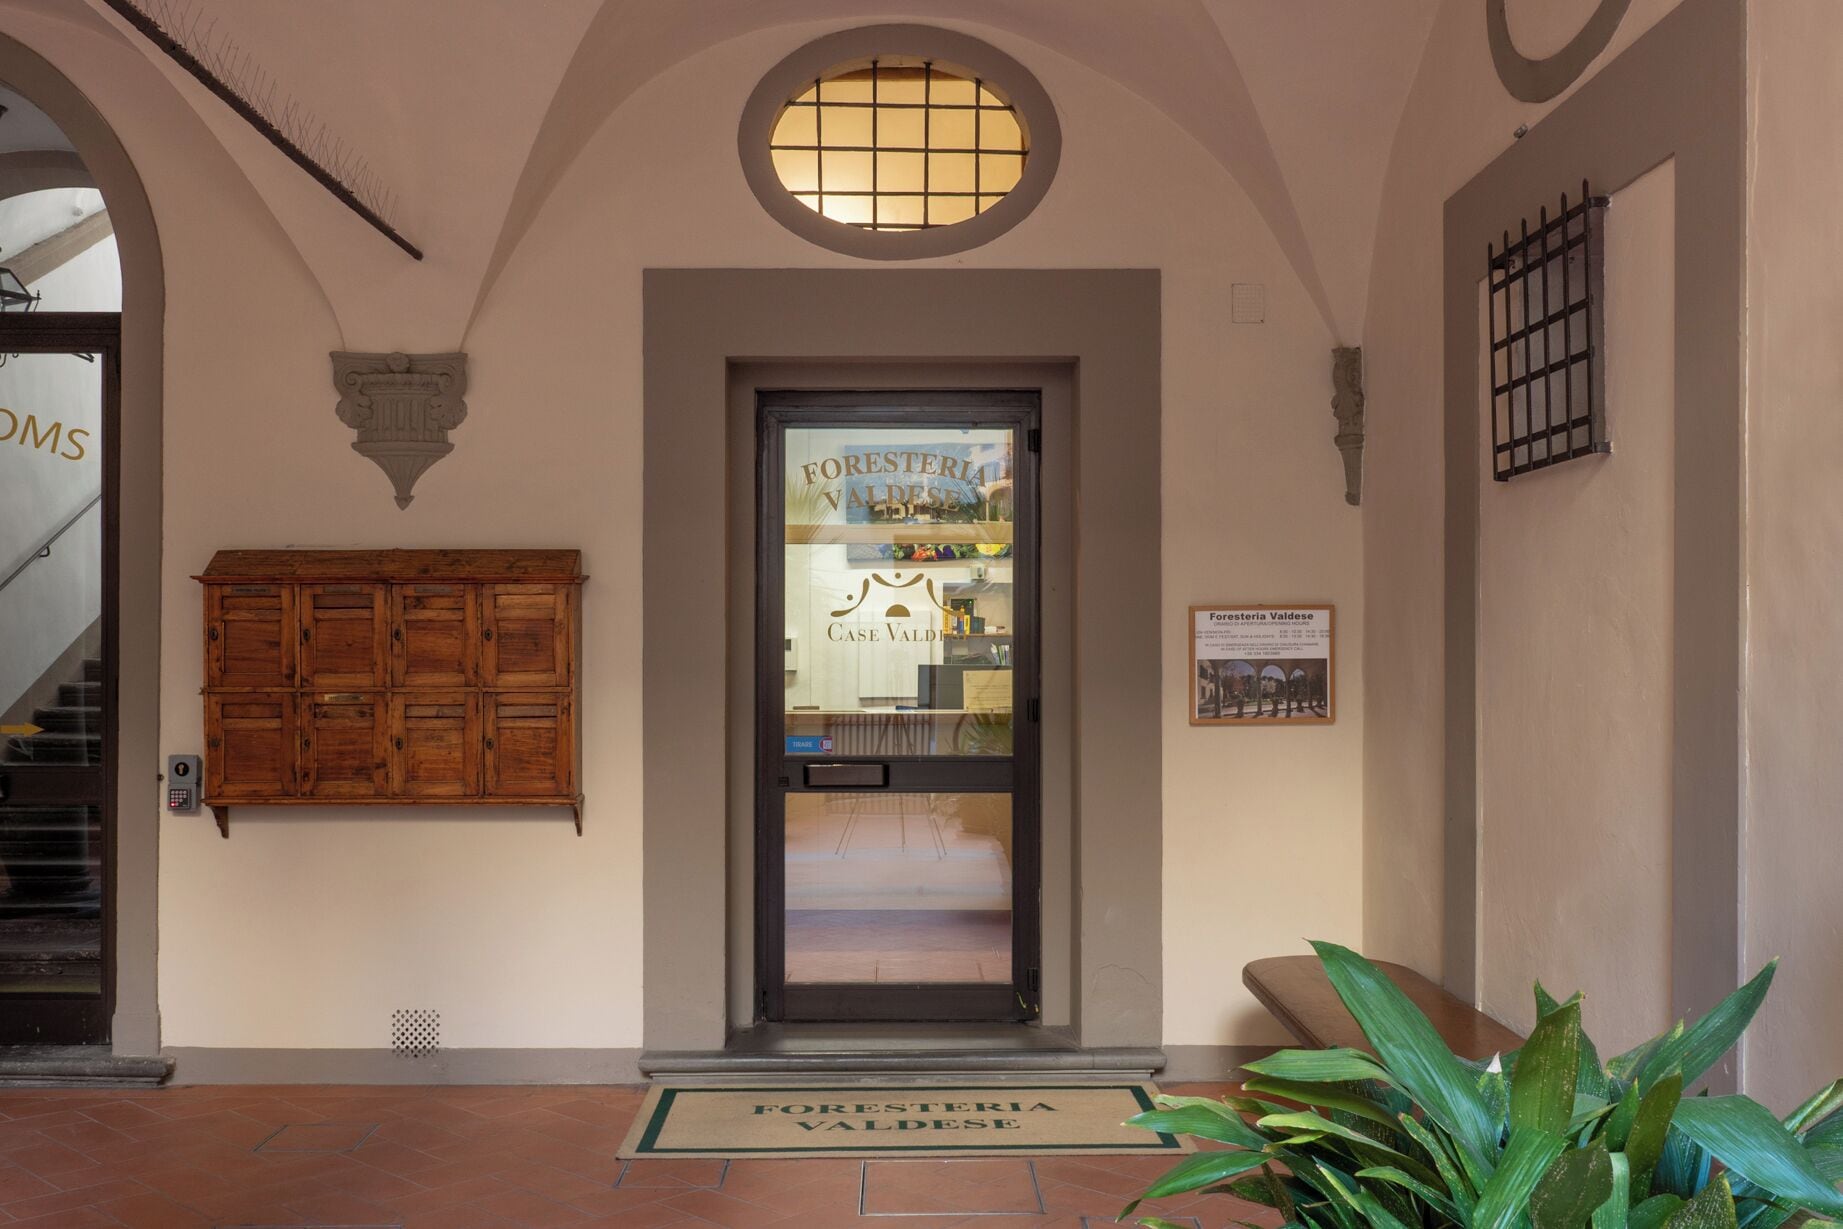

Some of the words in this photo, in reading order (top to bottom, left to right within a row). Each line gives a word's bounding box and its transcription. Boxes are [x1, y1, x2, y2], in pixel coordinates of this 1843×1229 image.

[800, 451, 987, 487] FORESTERIA
[823, 484, 961, 512] VALDESE
[1209, 612, 1266, 621] Foresteria
[1269, 612, 1314, 620] Valdese
[827, 622, 880, 641] CASE
[751, 1102, 1058, 1115] FORESTERIA
[796, 1118, 1021, 1131] VALDESE
